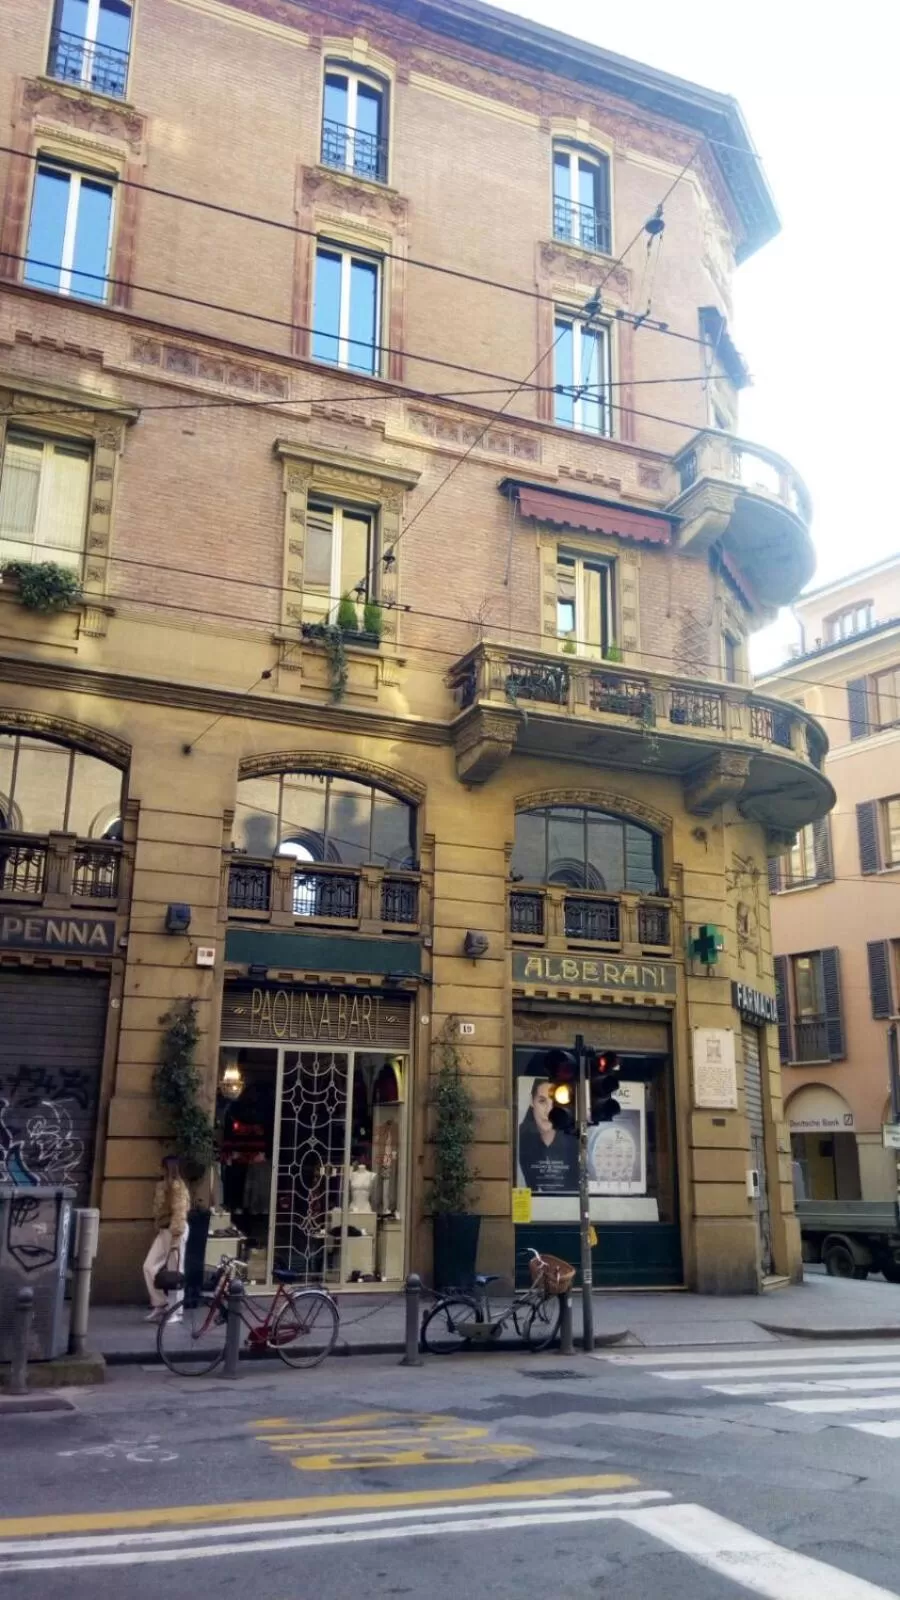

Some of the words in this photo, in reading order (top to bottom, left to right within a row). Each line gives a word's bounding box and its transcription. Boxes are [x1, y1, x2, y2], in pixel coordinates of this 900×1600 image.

[2, 916, 108, 948] PENNA
[524, 955, 665, 987] ALBERANI
[251, 988, 332, 1039] PAOLINA
[338, 993, 384, 1041] BART
[737, 982, 779, 1021] FARMACIA
